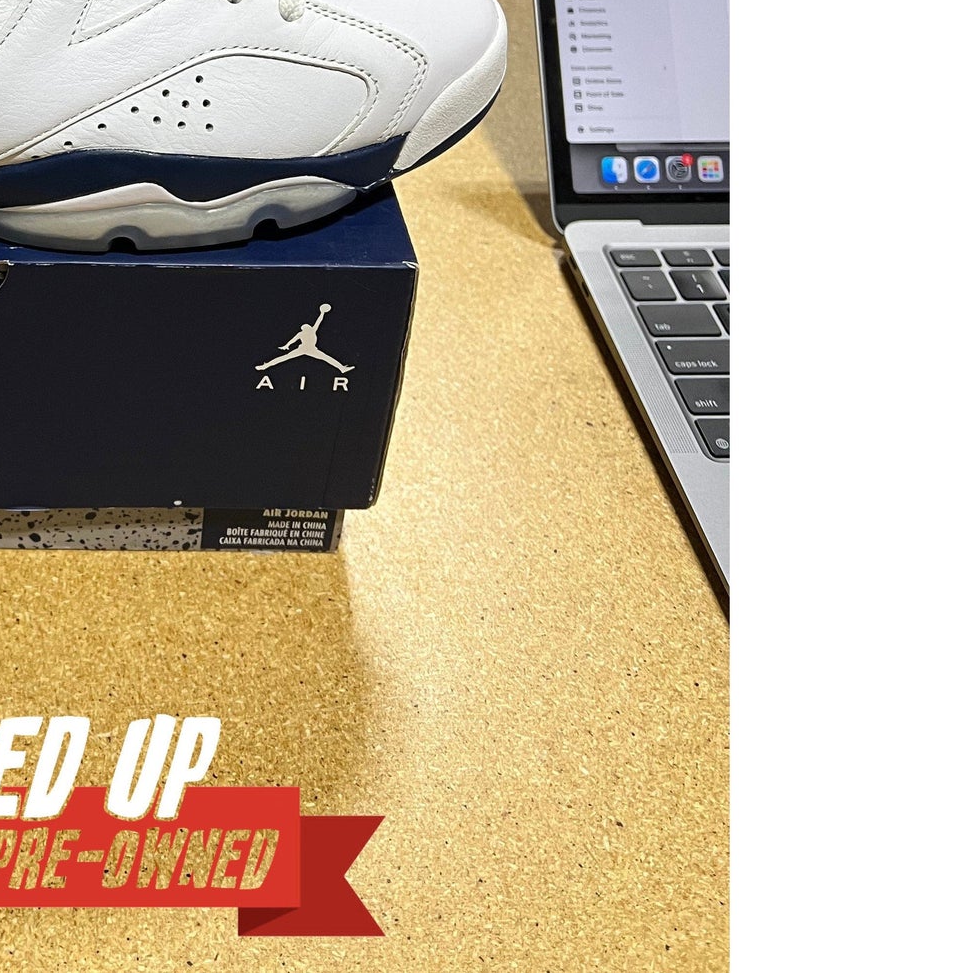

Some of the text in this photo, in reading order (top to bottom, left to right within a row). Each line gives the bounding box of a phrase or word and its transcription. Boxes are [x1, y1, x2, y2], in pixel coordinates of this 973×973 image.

[655, 323, 671, 331] tab
[675, 360, 718, 368] caps lock
[256, 375, 349, 391] AIR
[694, 399, 718, 408] shift
[263, 509, 328, 519] AIR JORDAN
[268, 521, 327, 530] MADE IN CHINA
[302, 530, 324, 539] CHINE
[219, 537, 323, 546] CAIXA FABRICADA NA CHINA
